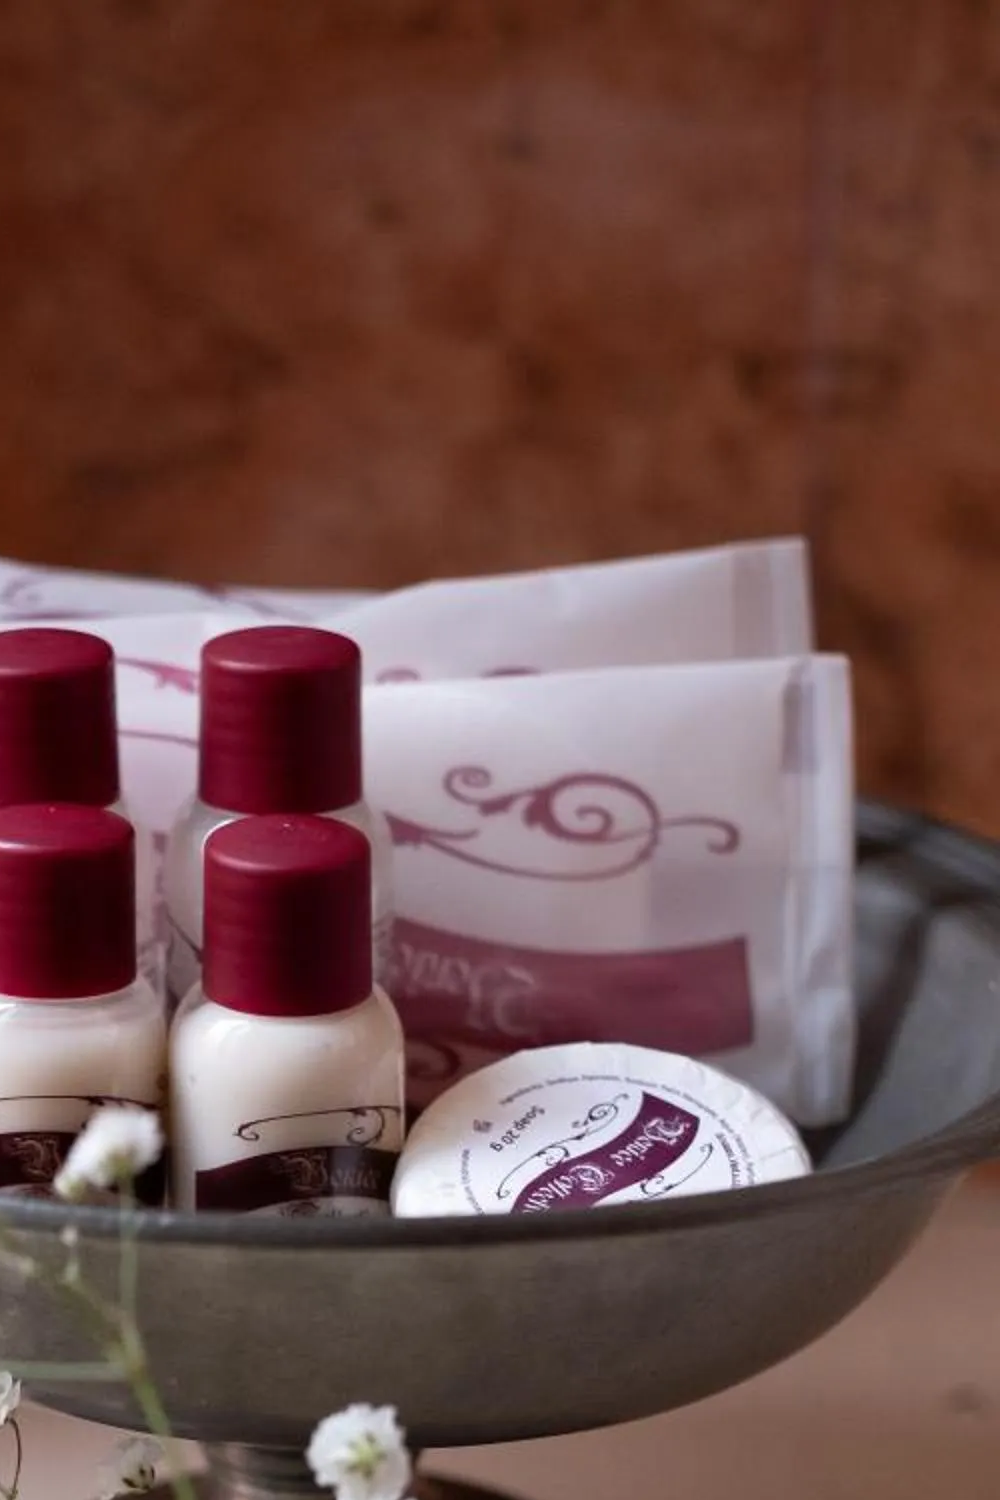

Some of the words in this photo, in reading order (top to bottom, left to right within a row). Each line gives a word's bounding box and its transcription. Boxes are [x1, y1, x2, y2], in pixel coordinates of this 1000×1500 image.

[514, 1105, 545, 1136] Soap
[489, 1141, 503, 1153] g
[503, 1128, 522, 1146] 20
[609, 1116, 691, 1167] Venice
[522, 1164, 614, 1213] Collecti
